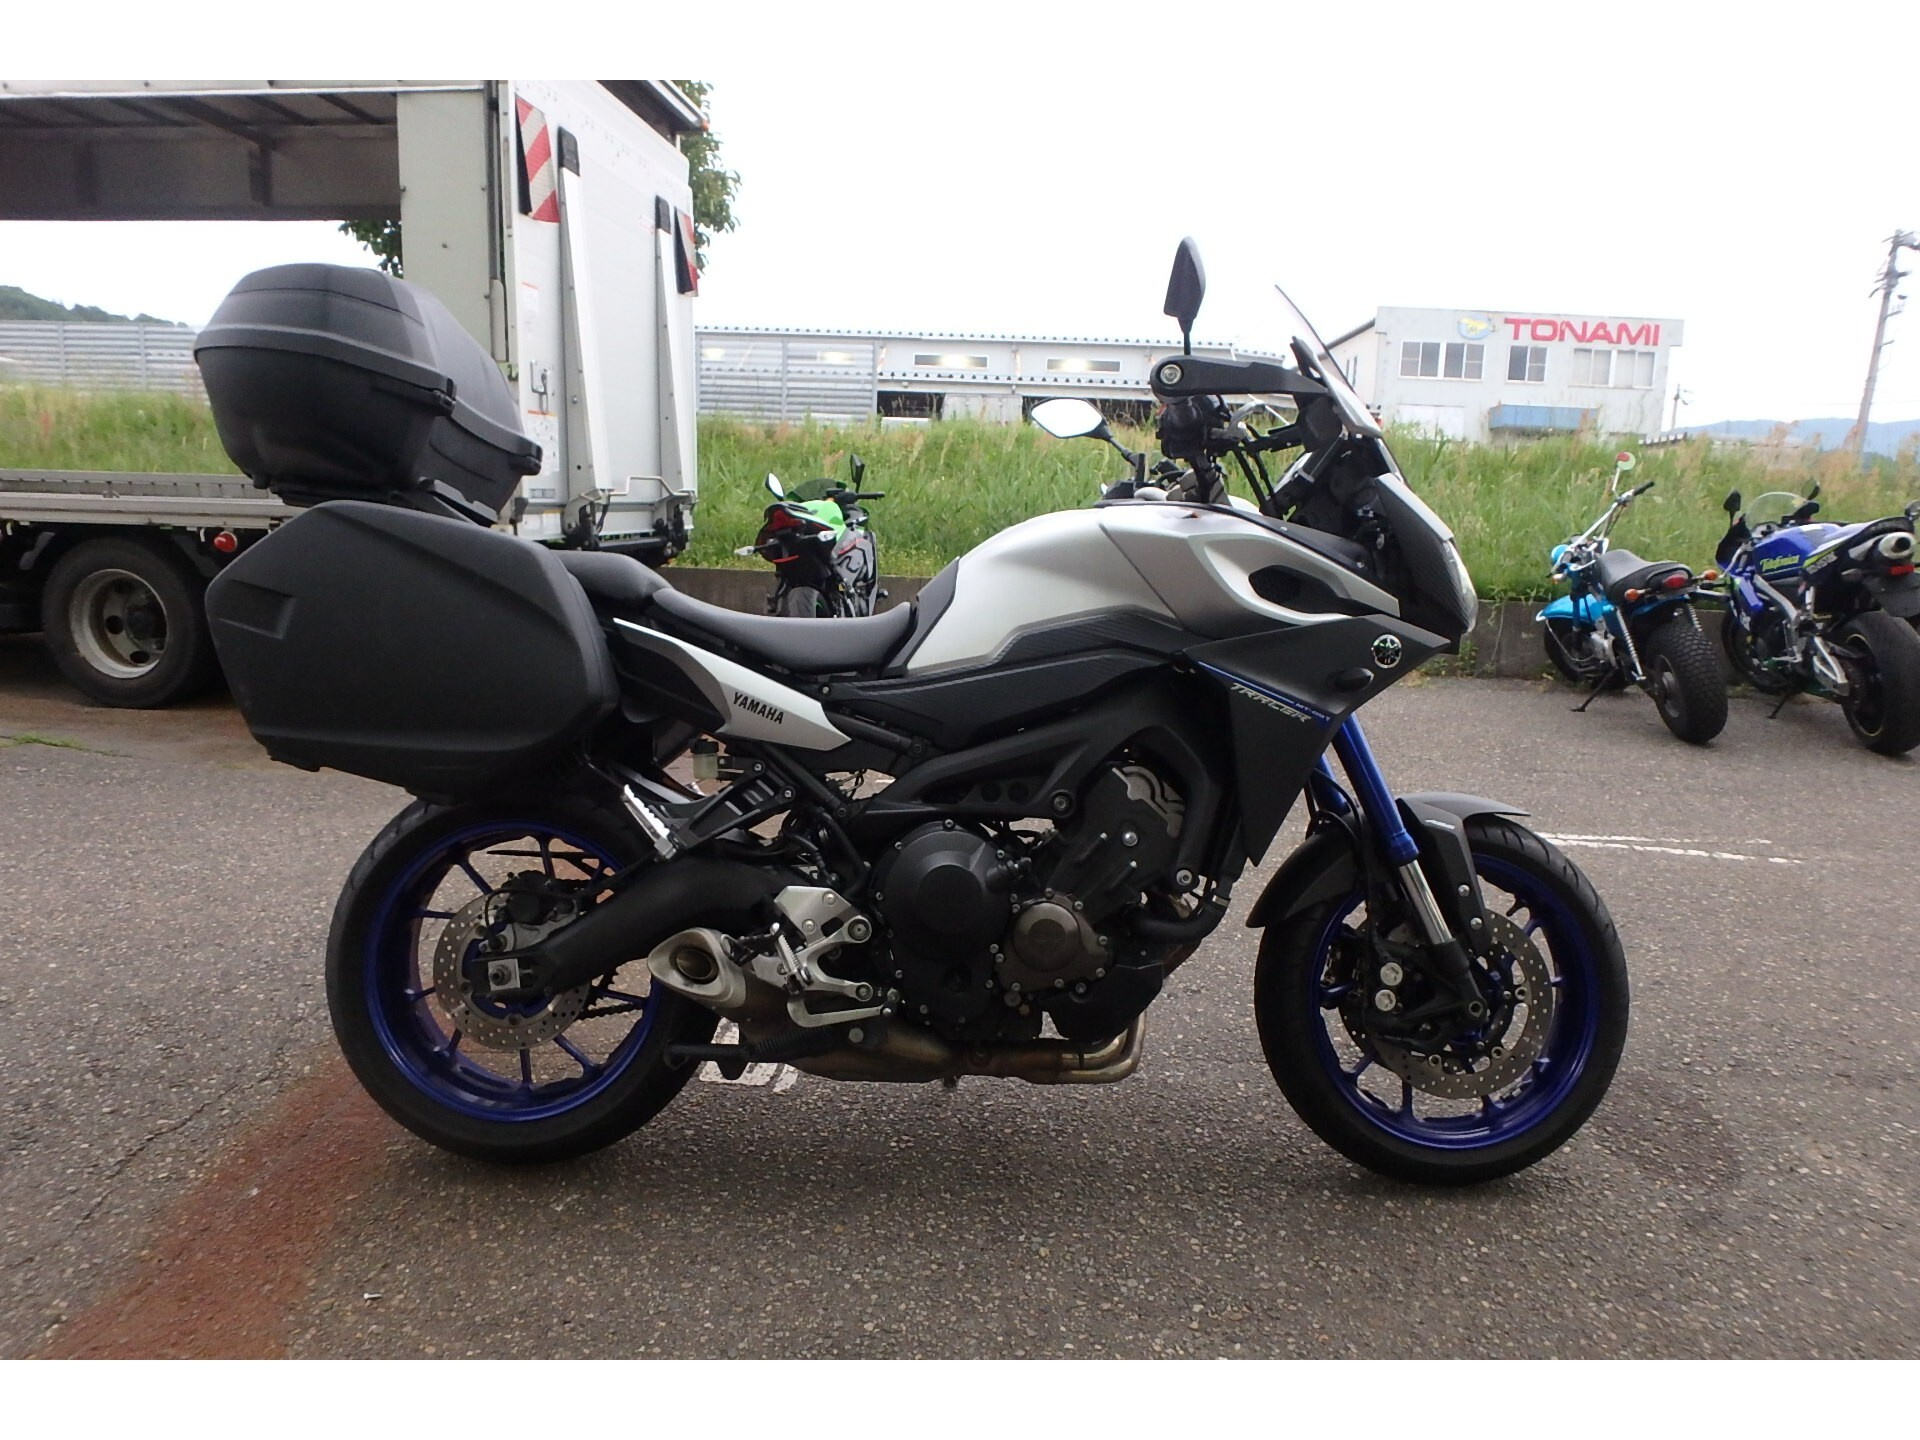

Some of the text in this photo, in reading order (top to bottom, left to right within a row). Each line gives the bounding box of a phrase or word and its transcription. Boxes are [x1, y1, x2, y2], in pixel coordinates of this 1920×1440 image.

[1504, 317, 1661, 347] TONAMI
[732, 691, 785, 725] YAMAHA
[1230, 682, 1312, 724] TRACER
